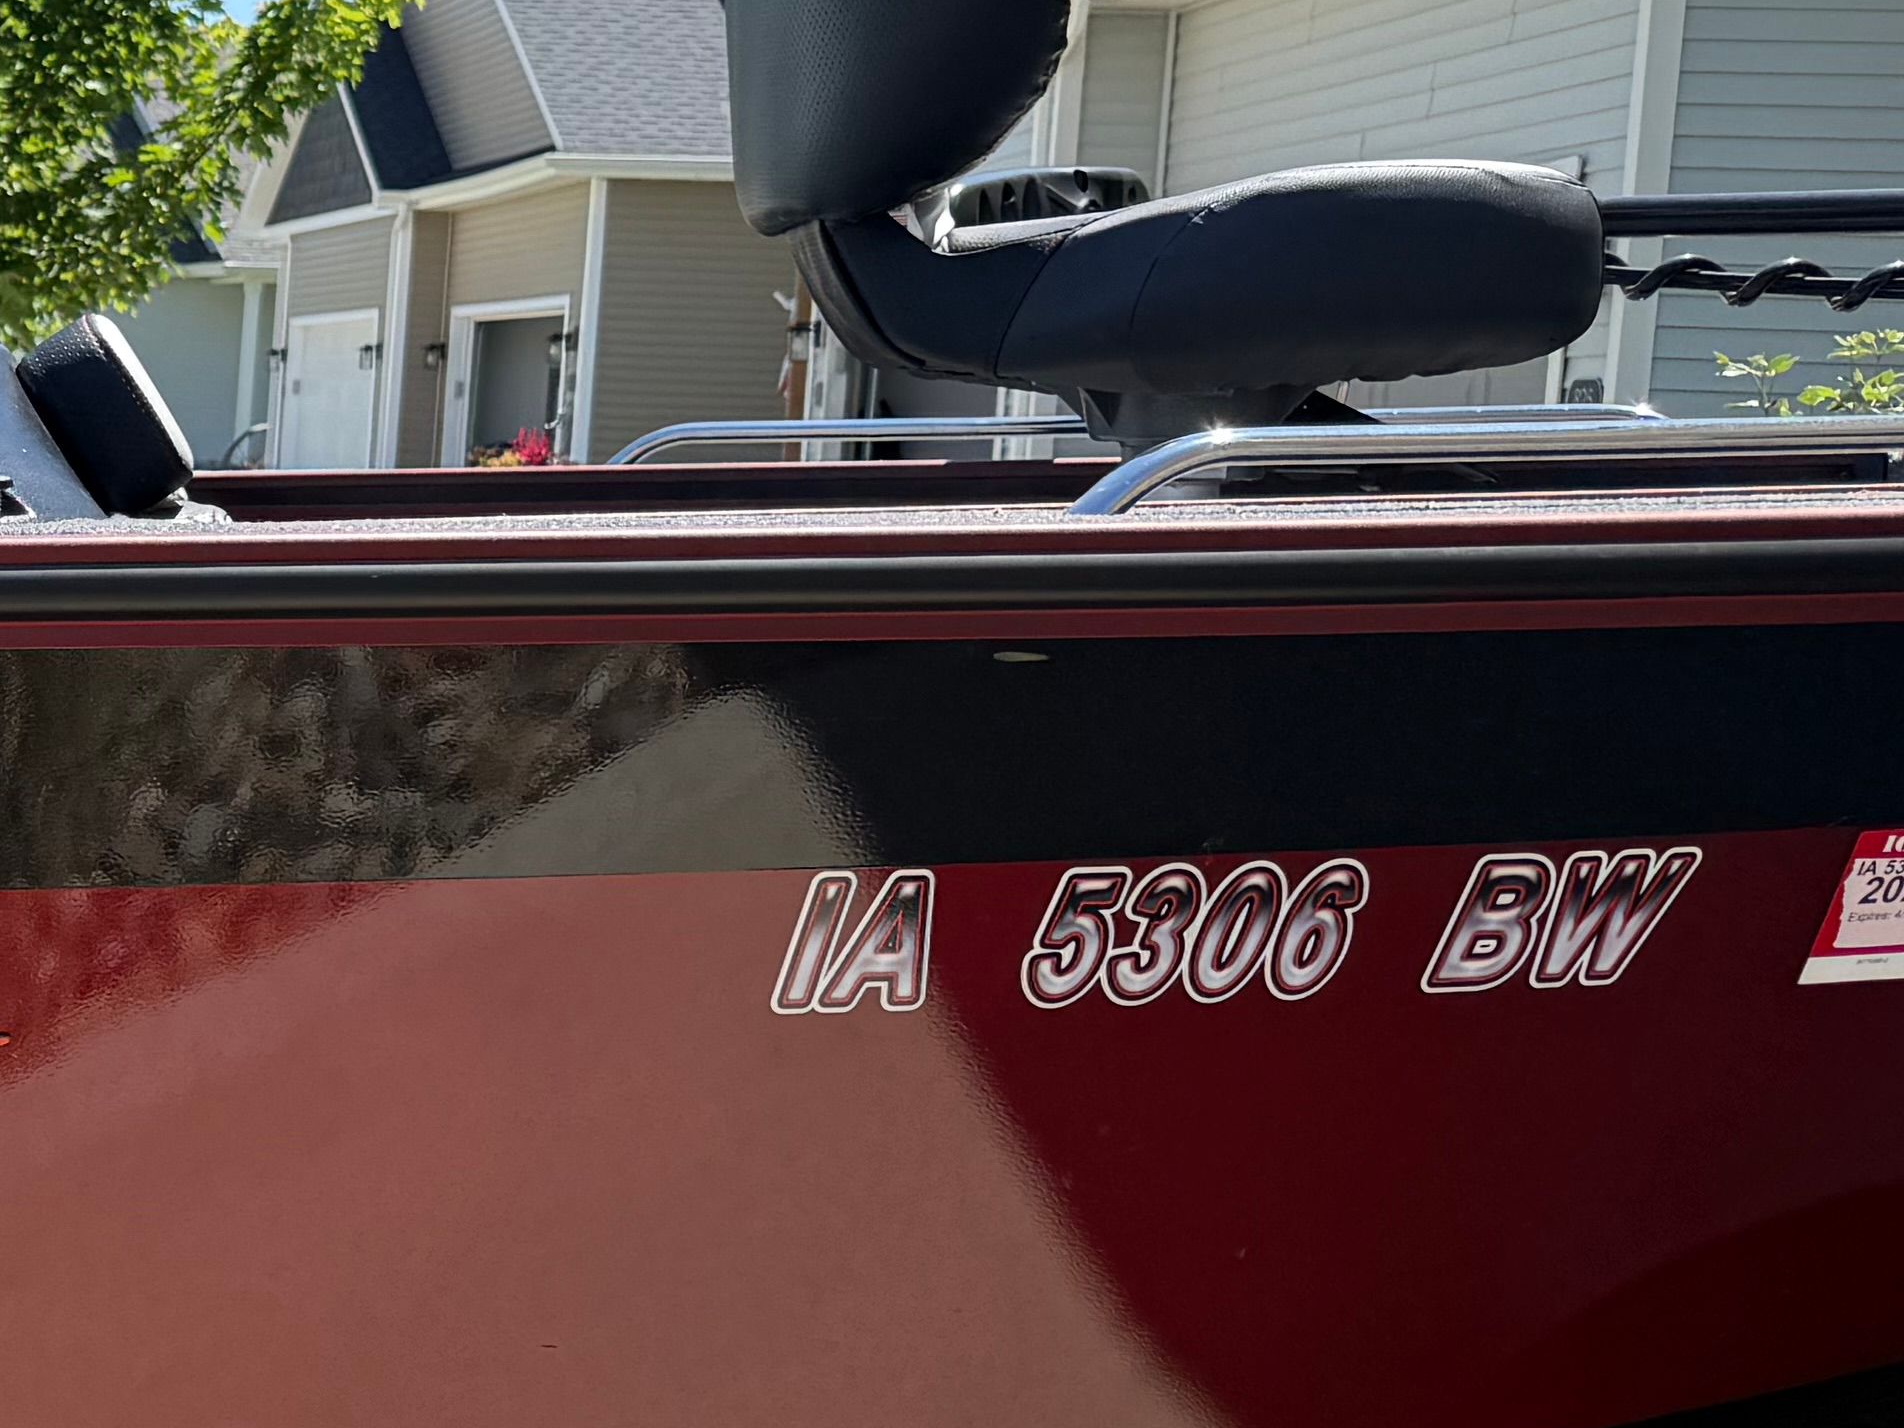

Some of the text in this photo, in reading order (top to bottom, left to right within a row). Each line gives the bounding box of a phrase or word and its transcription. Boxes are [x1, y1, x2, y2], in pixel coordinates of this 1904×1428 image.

[1857, 860, 1877, 876] IA
[1857, 875, 1904, 904] 20
[770, 846, 1703, 1014] IA 5306 BW
